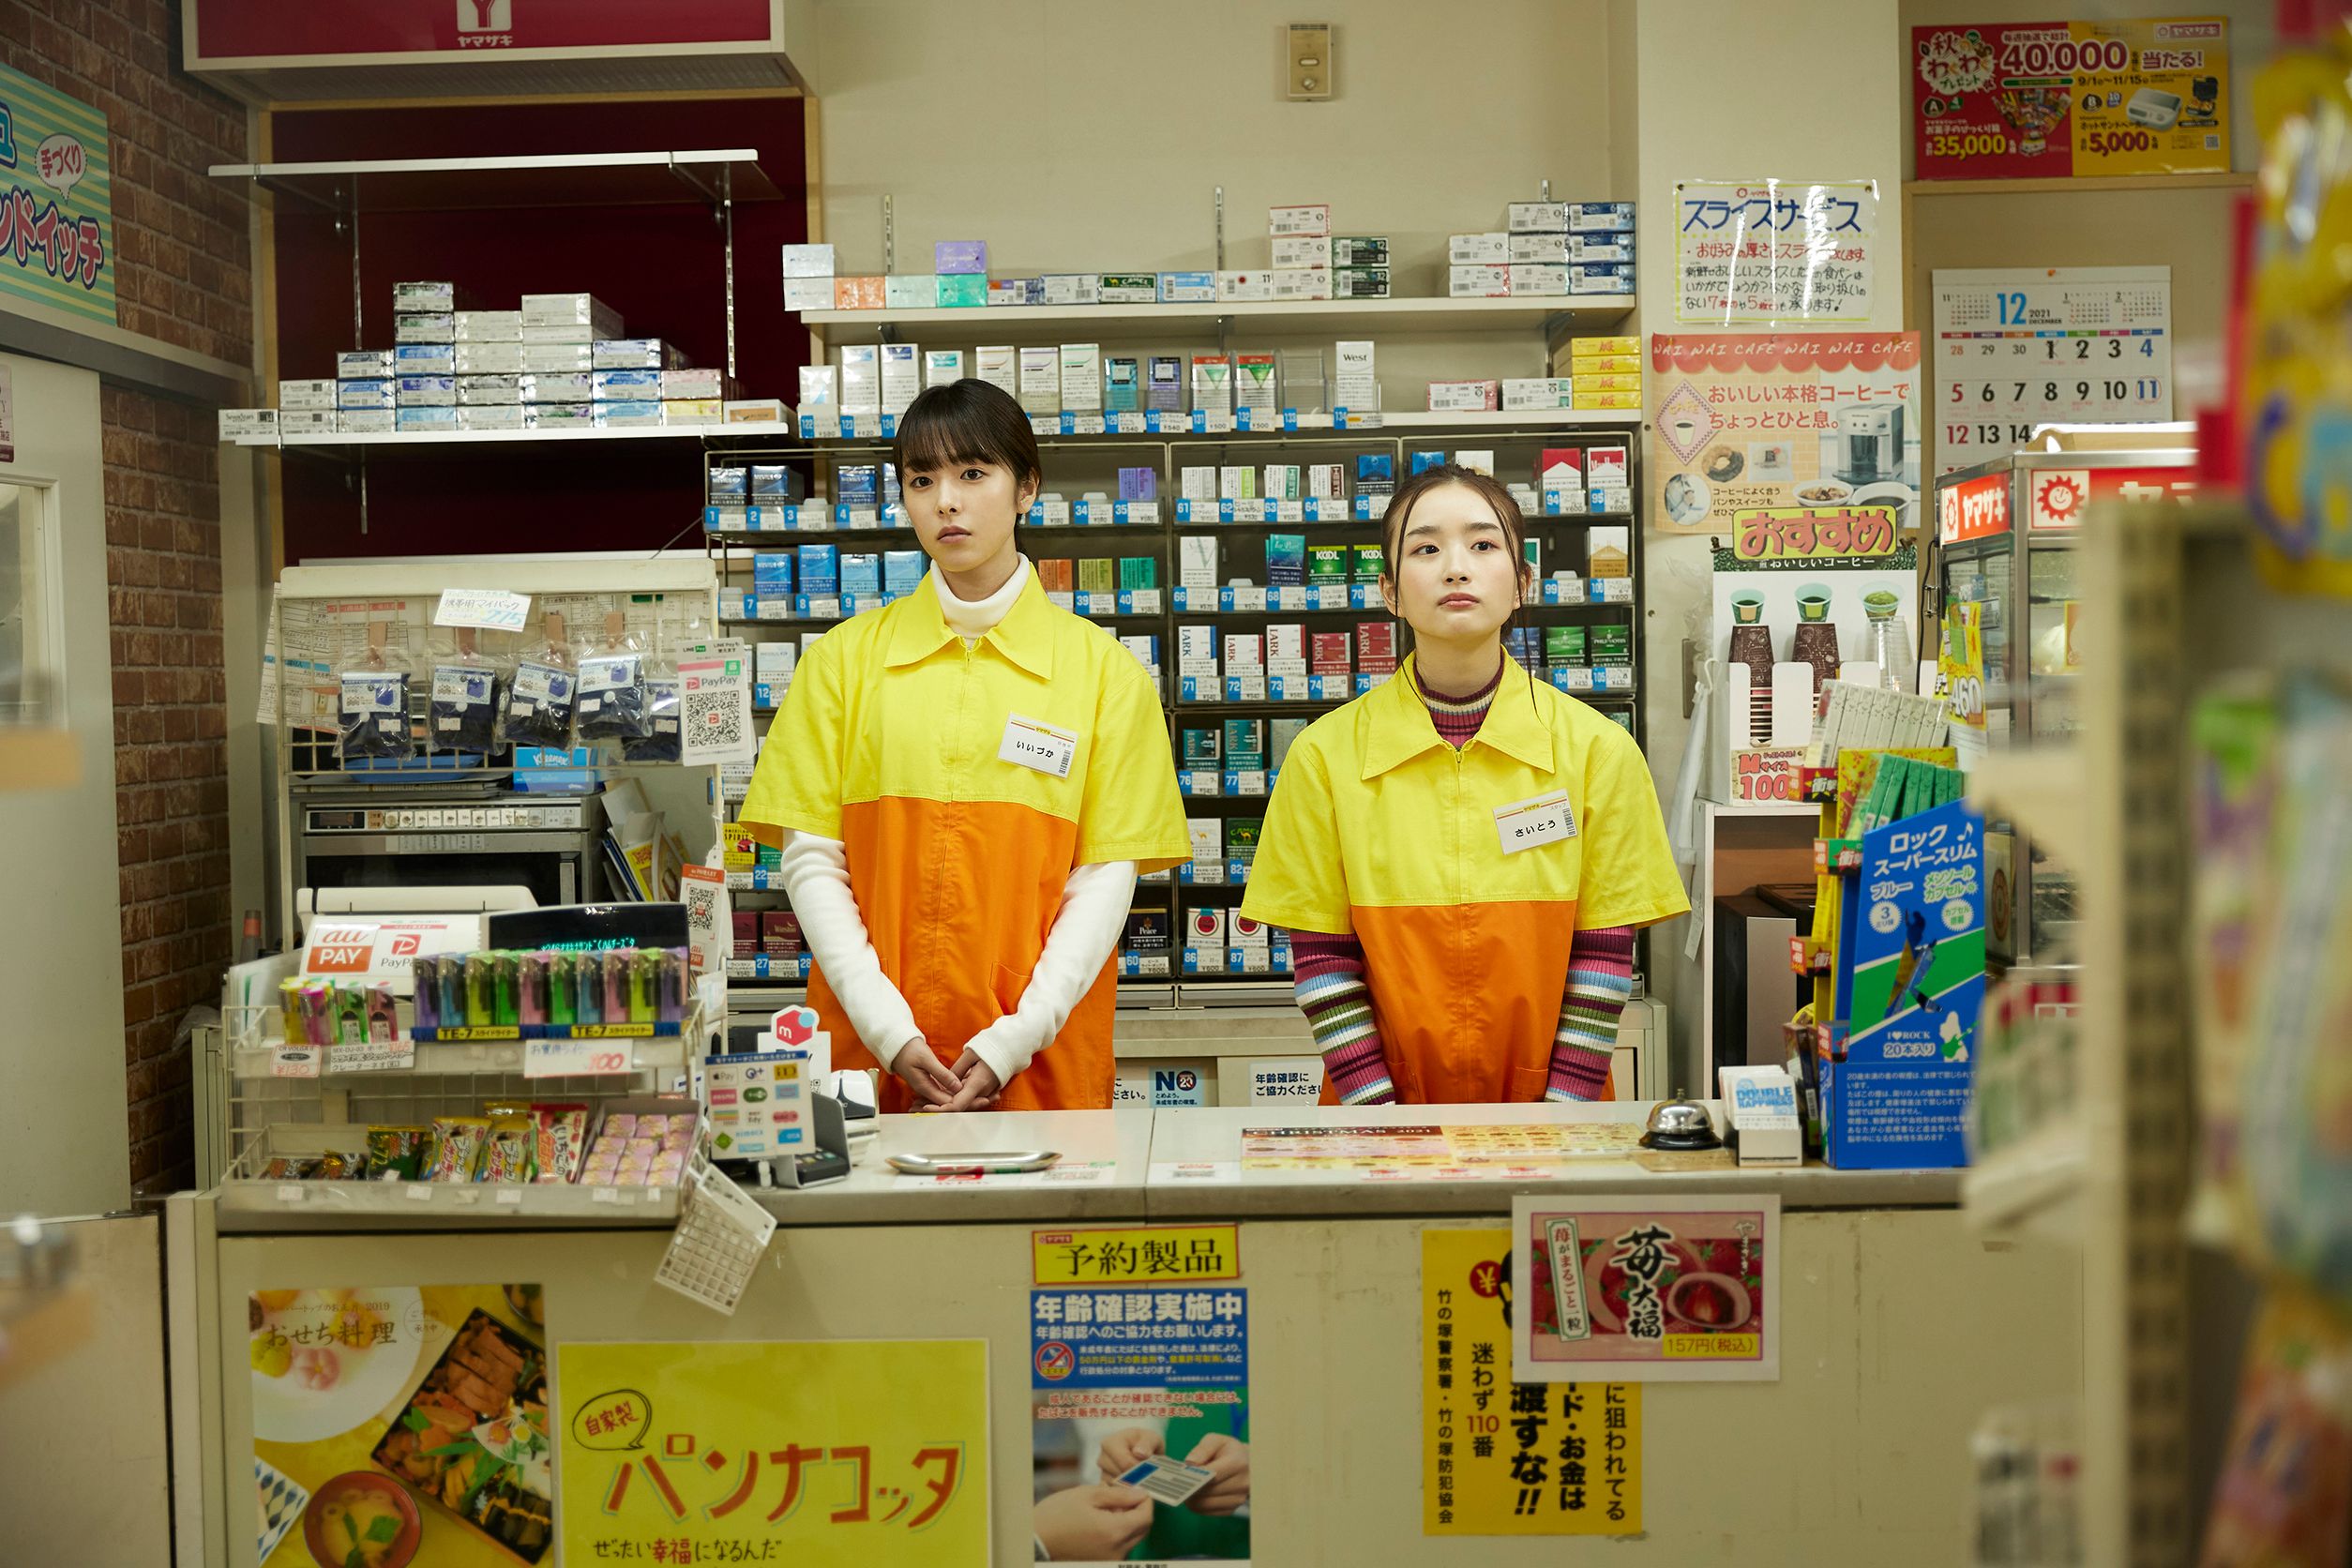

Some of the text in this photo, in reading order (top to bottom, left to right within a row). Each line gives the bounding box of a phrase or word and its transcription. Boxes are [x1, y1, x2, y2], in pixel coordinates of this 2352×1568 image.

[457, 35, 514, 48] ヤマザキ
[2002, 41, 2129, 73] 40,000
[1934, 134, 2006, 159] 35,000
[2088, 130, 2149, 157] 5,000
[41, 143, 82, 178] 手づくり
[1997, 293, 2027, 324] 12
[2029, 309, 2051, 318] 2021
[1691, 343, 1726, 356] WAI
[1735, 342, 1777, 355] CAFE
[1784, 342, 1820, 355] WAI
[1829, 341, 1865, 354] WAI
[1872, 340, 1914, 354] CAFE
[1951, 339, 2153, 358] 28 29 30 1 2 3 4
[1343, 353, 1368, 362] West
[1708, 384, 1910, 404] おいしい本格コーヒーで
[1952, 380, 2158, 402] 5 6 7 8 9 10 11
[1193, 413, 1205, 425] 131
[1238, 411, 1250, 423] 132
[1710, 411, 1840, 430] ちょっとひと息。
[801, 418, 814, 430] 122
[841, 417, 854, 430] 123
[1947, 424, 2031, 444] 12 13 14
[1712, 487, 1781, 496] コーヒーによく合う
[1546, 494, 1559, 505] 94
[1591, 493, 1605, 504] 95
[1712, 497, 1774, 506] パンやスイーツも
[1075, 505, 1087, 515] 34
[1115, 505, 1127, 515] 35
[1177, 503, 1189, 513] 61
[1221, 503, 1233, 513] 62
[1304, 502, 1318, 512] 64
[1356, 500, 1368, 510] 65
[1962, 486, 2006, 530] ヤマザキ
[709, 511, 716, 520] 1
[750, 511, 758, 521] 2
[787, 510, 794, 520] 3
[839, 509, 847, 519] 4
[1740, 509, 1895, 556] おすすめ
[1316, 550, 1340, 561] KOOL
[1351, 589, 1364, 599] 70
[1545, 582, 1558, 594] 99
[1077, 596, 1089, 606] 39
[1119, 595, 1131, 605] 40
[1173, 592, 1186, 602] 66
[1221, 592, 1233, 602] 67
[1267, 591, 1279, 601] 68
[1306, 590, 1319, 600] 69
[746, 599, 754, 609] 7
[799, 599, 807, 610] 8
[845, 597, 852, 607] 9
[1182, 628, 1192, 657] LARK
[1269, 628, 1279, 657] LARK
[1359, 626, 1370, 655] LARK
[1228, 638, 1236, 662] LARK
[1314, 636, 1324, 661] LARK
[701, 676, 739, 687] PayPay
[1183, 682, 1196, 692] 71
[1228, 681, 1241, 691] 72
[1270, 681, 1283, 691] 73
[1309, 680, 1322, 690] 74
[1357, 678, 1369, 689] 75
[758, 687, 769, 699] 12
[1016, 740, 1055, 759] いいづか
[1226, 775, 1238, 786] 77
[1741, 774, 1789, 801] 100
[1515, 819, 1557, 838] さいとう
[1890, 824, 1948, 853] ロック
[1874, 842, 1978, 877] スーパースリム
[754, 869, 767, 881] 22
[1180, 864, 1193, 874] 81
[1229, 864, 1243, 874] 82
[1924, 864, 1976, 887] メンソール
[1871, 882, 1914, 901] ブルー
[1923, 882, 1965, 904] カプセル
[1880, 906, 1891, 919] 3
[322, 928, 368, 943] au
[1138, 927, 1157, 936] Peace
[319, 947, 360, 965] PAY
[1126, 956, 1138, 966] 60
[1184, 952, 1197, 963] 86
[1230, 952, 1244, 963] 87
[1273, 952, 1286, 962] 88
[756, 957, 769, 968] 27
[799, 957, 811, 968] 28
[440, 1028, 473, 1039] TE-7
[574, 1026, 608, 1037] TE-7
[1883, 1042, 1936, 1058] 20本入り
[1255, 1072, 1310, 1084] 年齢確認に
[1055, 1238, 1223, 1276] 予約製品
[1610, 1225, 1679, 1340] 苺大福
[365, 1302, 390, 1312] 2019
[1034, 1292, 1244, 1323] 年齢確認実施中
[266, 1320, 398, 1348] おせち料理
[1035, 1324, 1244, 1340] 年齢確認へのご協力をお願いします。
[1667, 1335, 1755, 1354] 157円(税込)
[1049, 1392, 1243, 1406] 成人であることが確認できない場合には、
[1466, 1342, 1500, 1458] 迷わず110番
[1038, 1405, 1204, 1419] たばこを販売することができません。
[1437, 1289, 1454, 1524] 竹の塚警察署・竹の塚防犯協会
[584, 1401, 641, 1437] 自家製
[1605, 1383, 1627, 1522] に狙われてる
[605, 1433, 961, 1530] パンナコッタ
[593, 1537, 783, 1564] ぜったい幸福になるんだ
